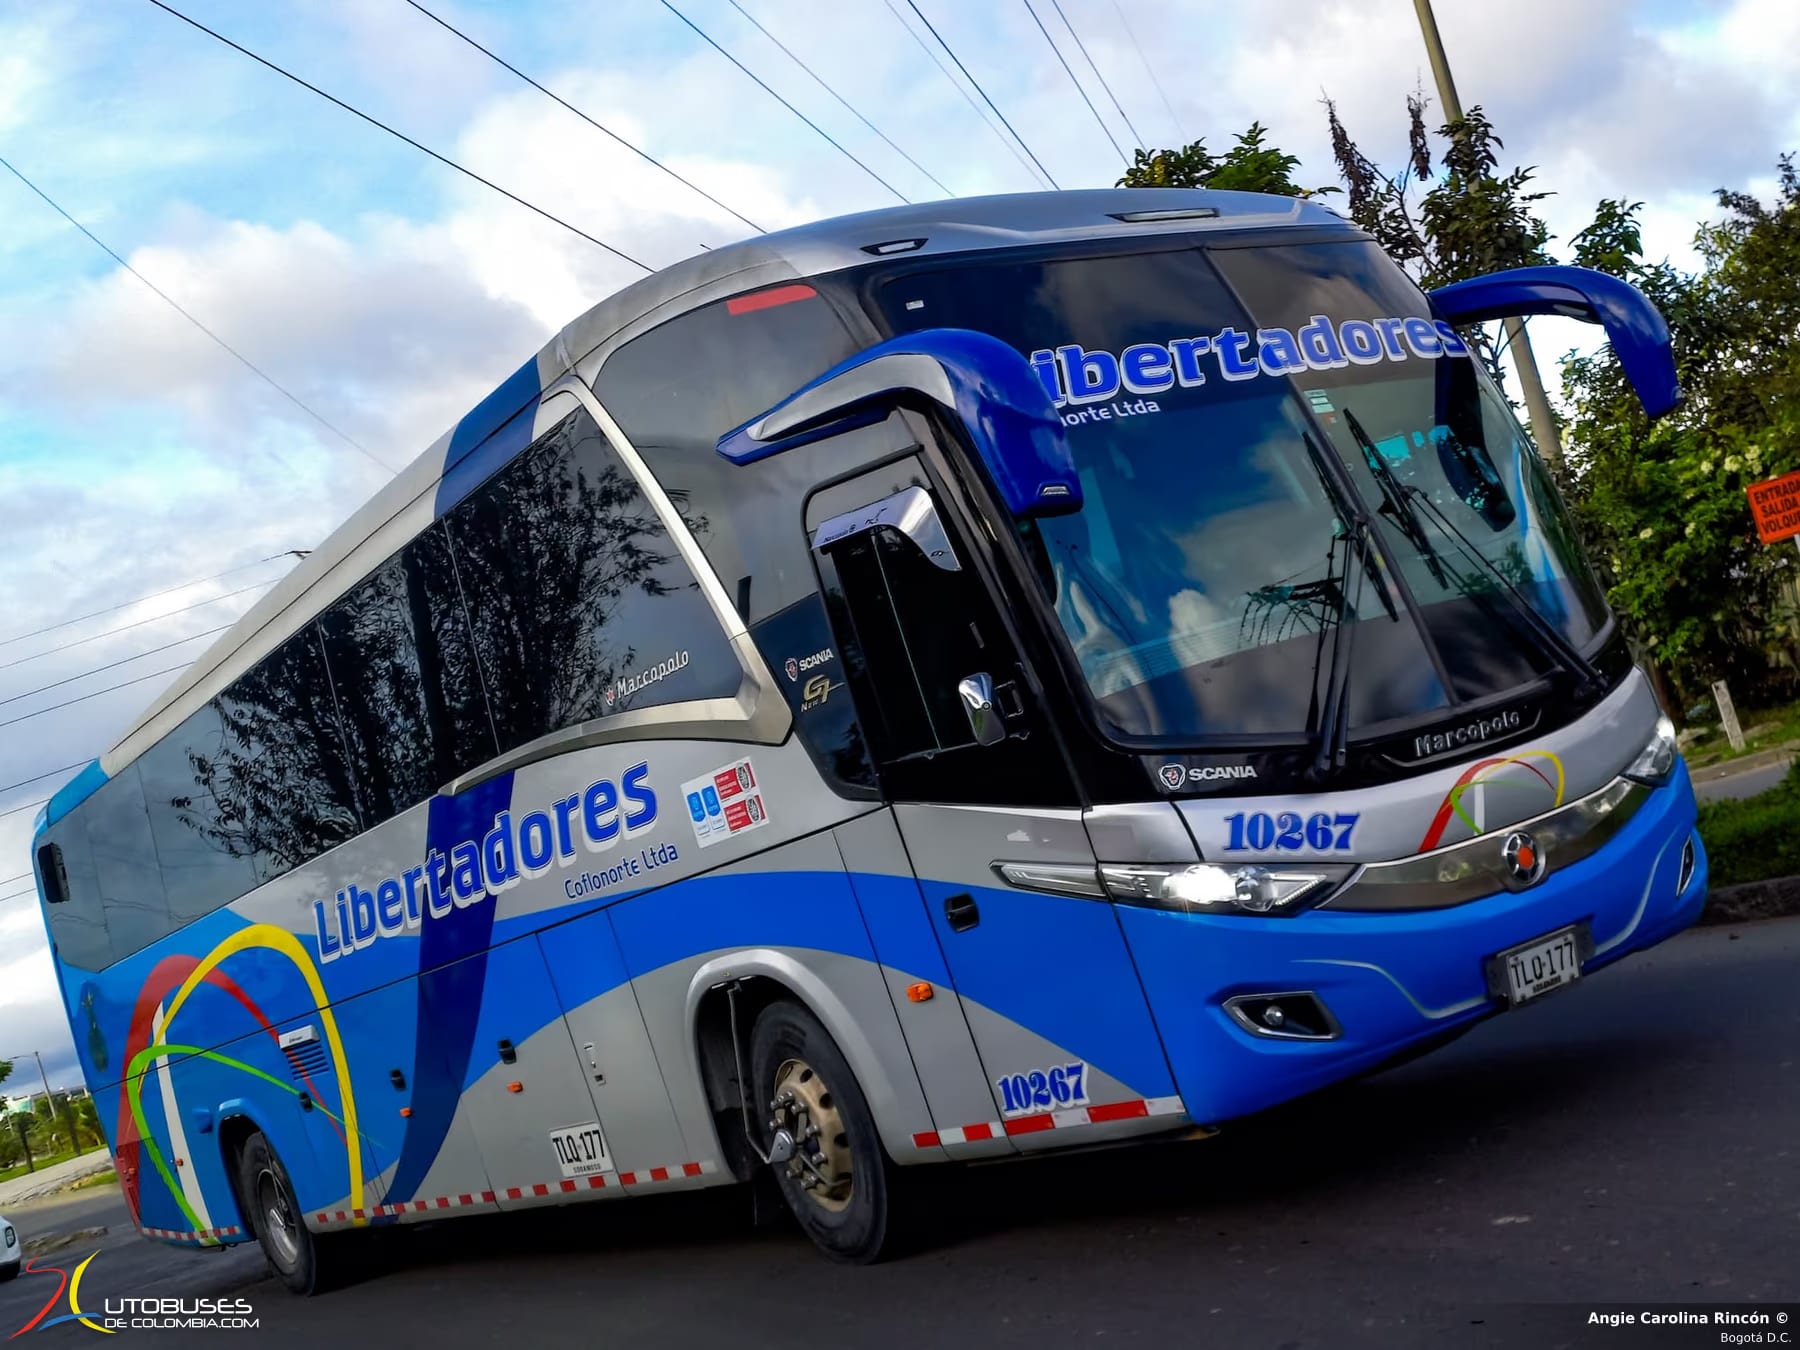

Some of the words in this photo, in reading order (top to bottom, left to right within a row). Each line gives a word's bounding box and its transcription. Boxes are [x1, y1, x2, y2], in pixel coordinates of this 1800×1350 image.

[1030, 315, 1469, 408] ibertadores
[1112, 399, 1161, 417] Ltda
[1761, 496, 1799, 518] SALIDA
[616, 650, 689, 698] Marcopolo
[799, 648, 834, 671] SCANIA
[1415, 710, 1521, 758] Marcopolo
[1188, 764, 1259, 782] SCANIA
[1223, 811, 1361, 854] 10267
[313, 760, 658, 964] Libertadores
[564, 857, 640, 899] Coflonorte
[641, 842, 679, 870] Ltda
[997, 1061, 1087, 1114] 10267
